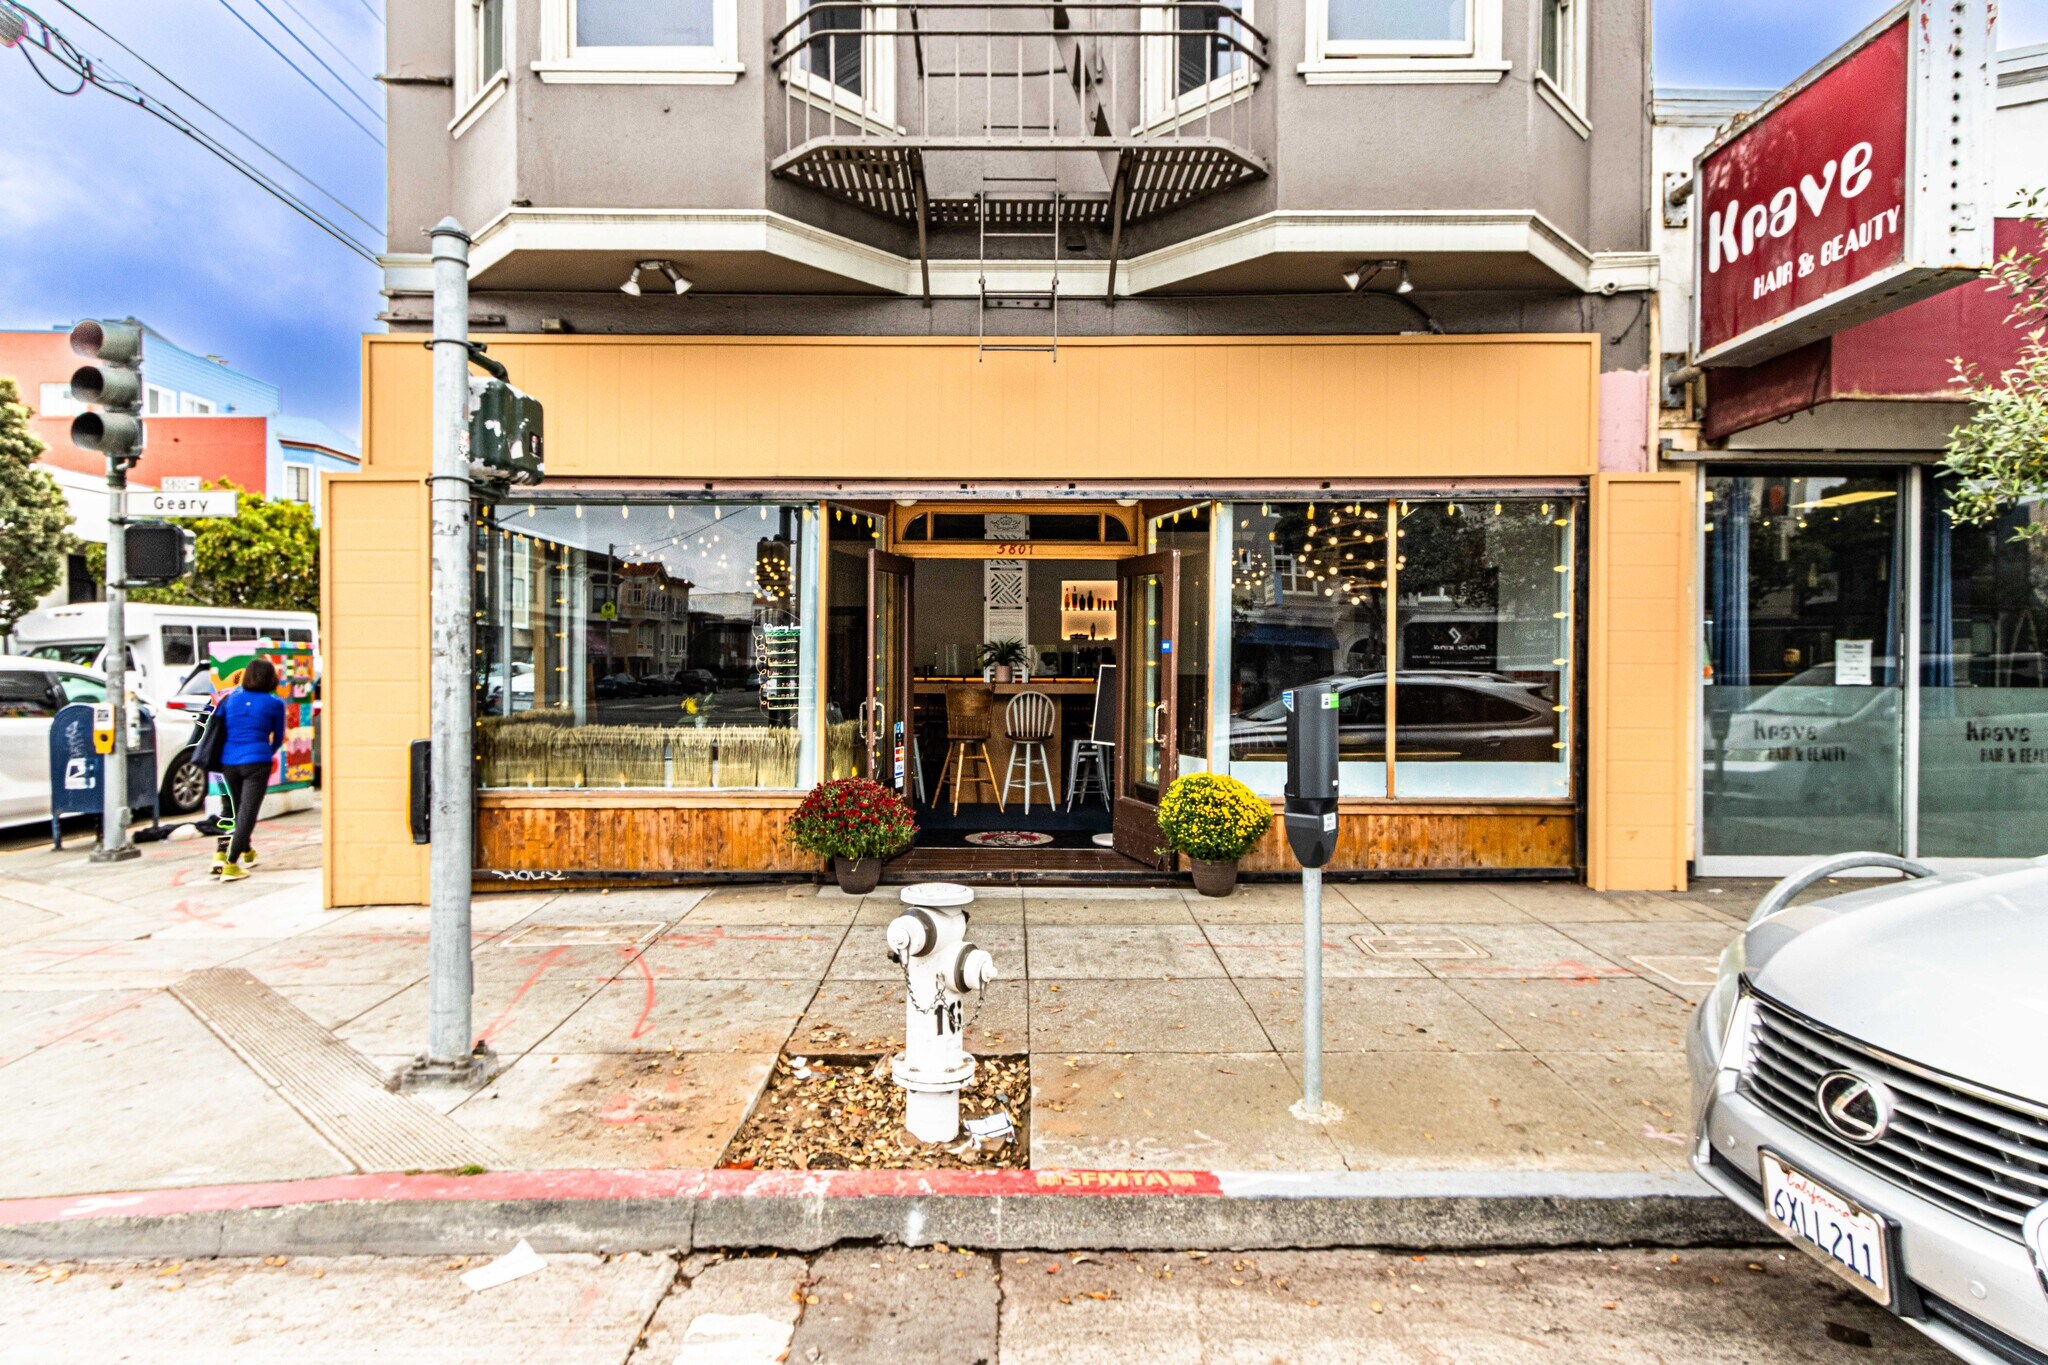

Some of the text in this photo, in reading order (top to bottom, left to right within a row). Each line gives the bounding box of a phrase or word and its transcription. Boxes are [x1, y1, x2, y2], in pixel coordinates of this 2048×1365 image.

[1709, 141, 1873, 273] Krave
[1754, 204, 1901, 300] HAIR & BEAUTY
[154, 496, 208, 512] Geary
[997, 544, 1034, 555] 5801
[1966, 720, 2031, 742] Krave
[1064, 1171, 1169, 1187] SFMTA
[1786, 1169, 1851, 1219] California
[1774, 1188, 1877, 1286] 6XLL211
